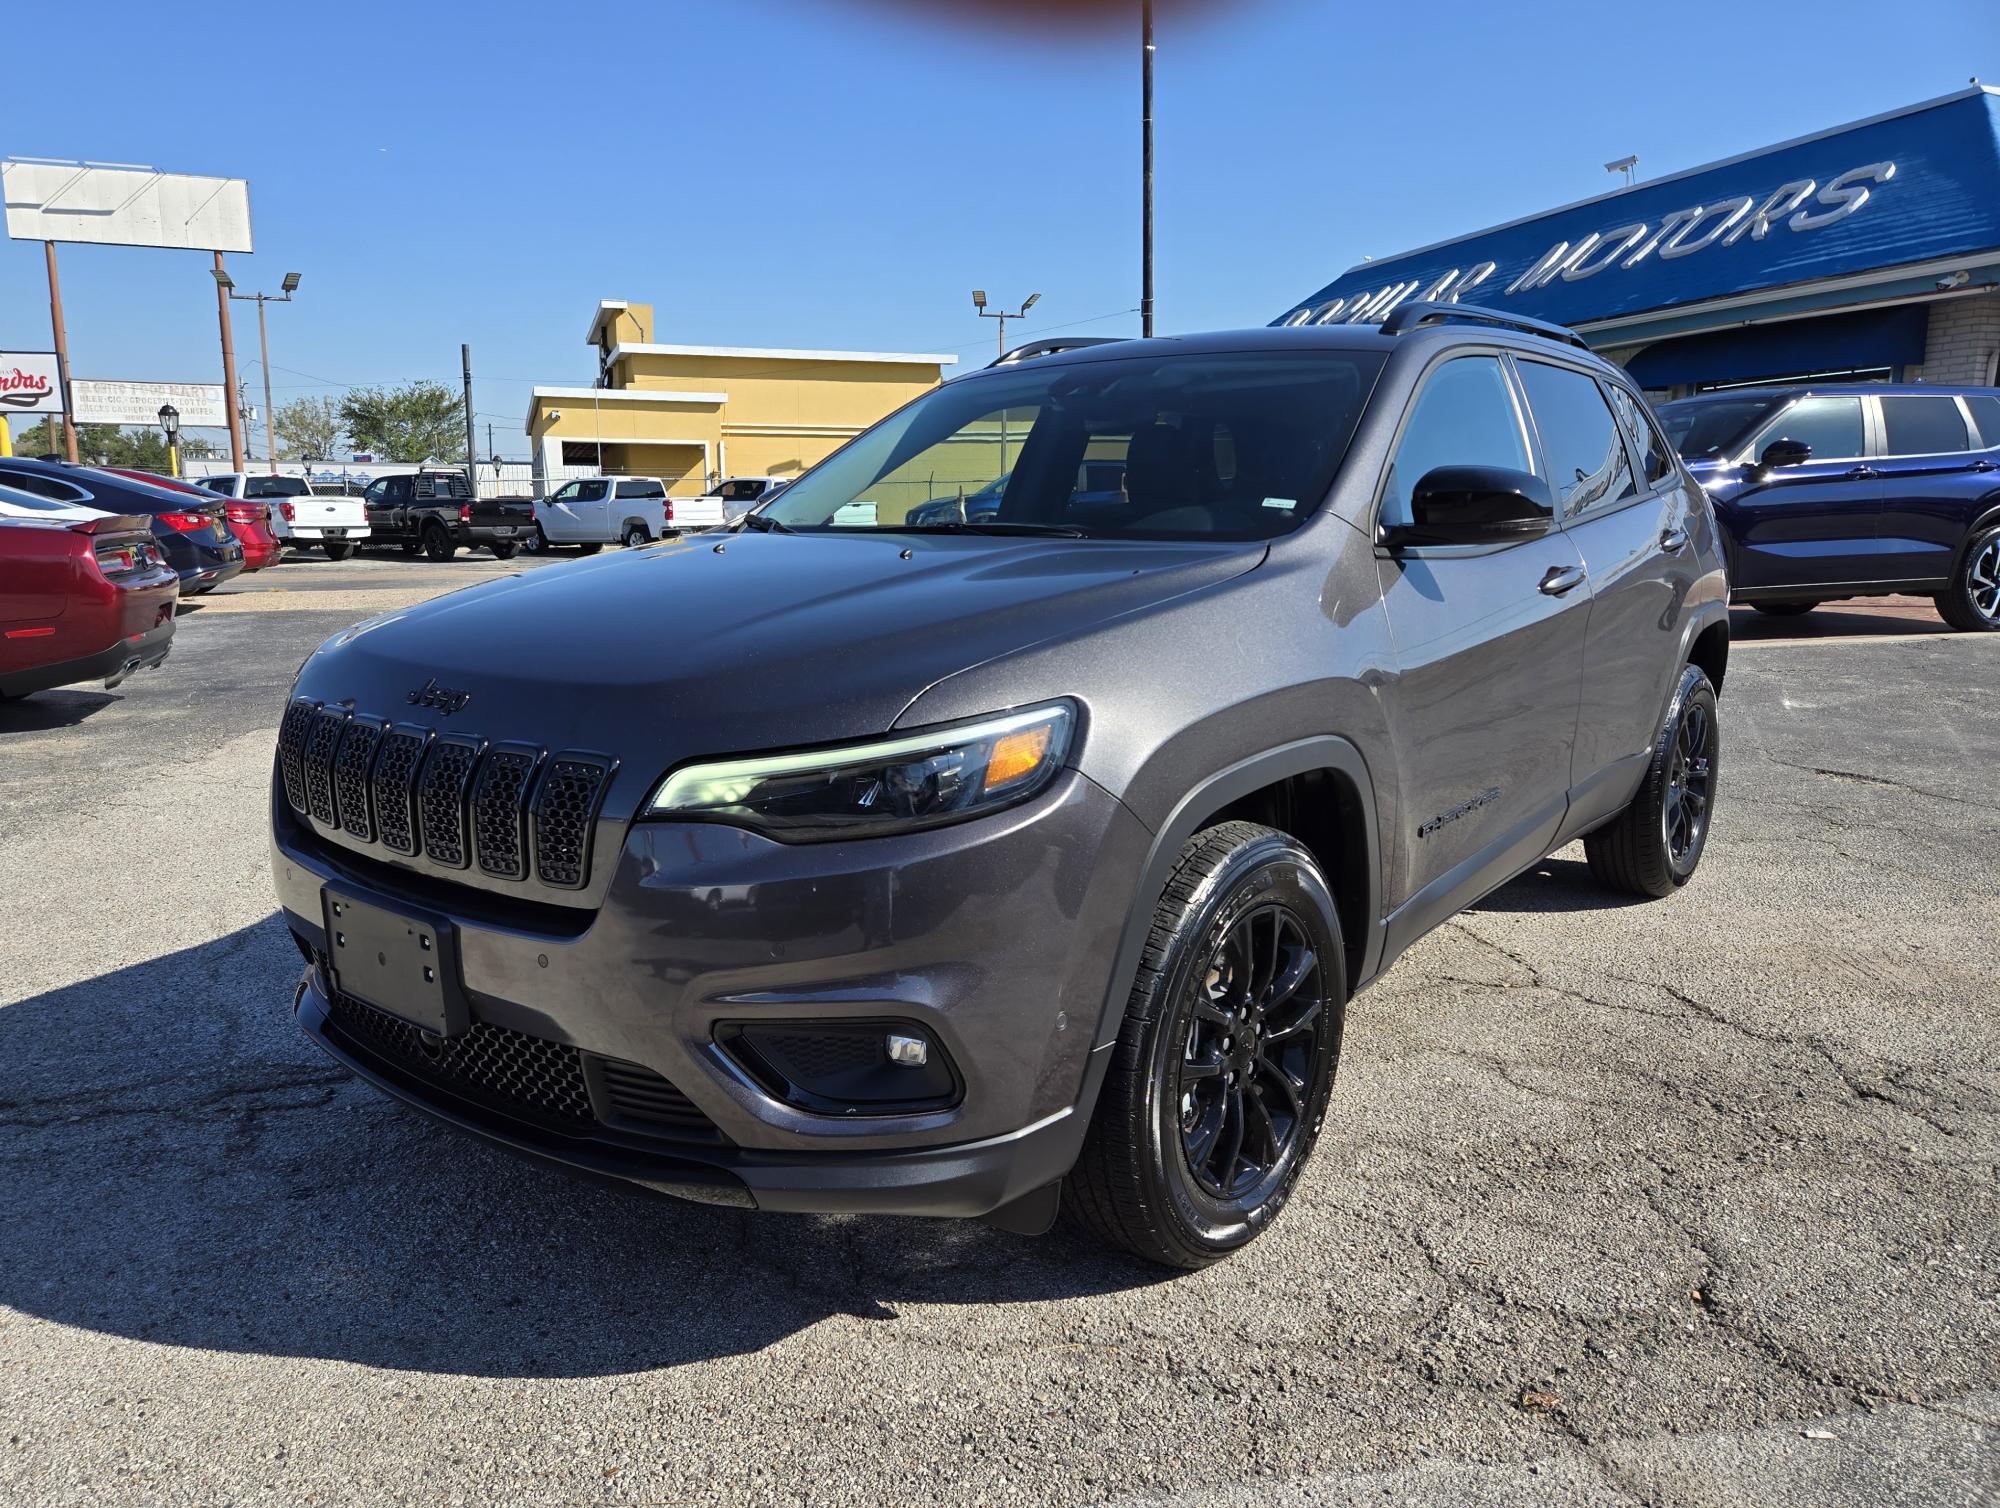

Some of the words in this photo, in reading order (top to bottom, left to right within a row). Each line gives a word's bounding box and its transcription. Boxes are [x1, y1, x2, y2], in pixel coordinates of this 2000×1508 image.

[1504, 161, 1897, 296] MOTORS
[179, 398, 208, 406] LOTTO
[405, 677, 472, 717] Jeep
